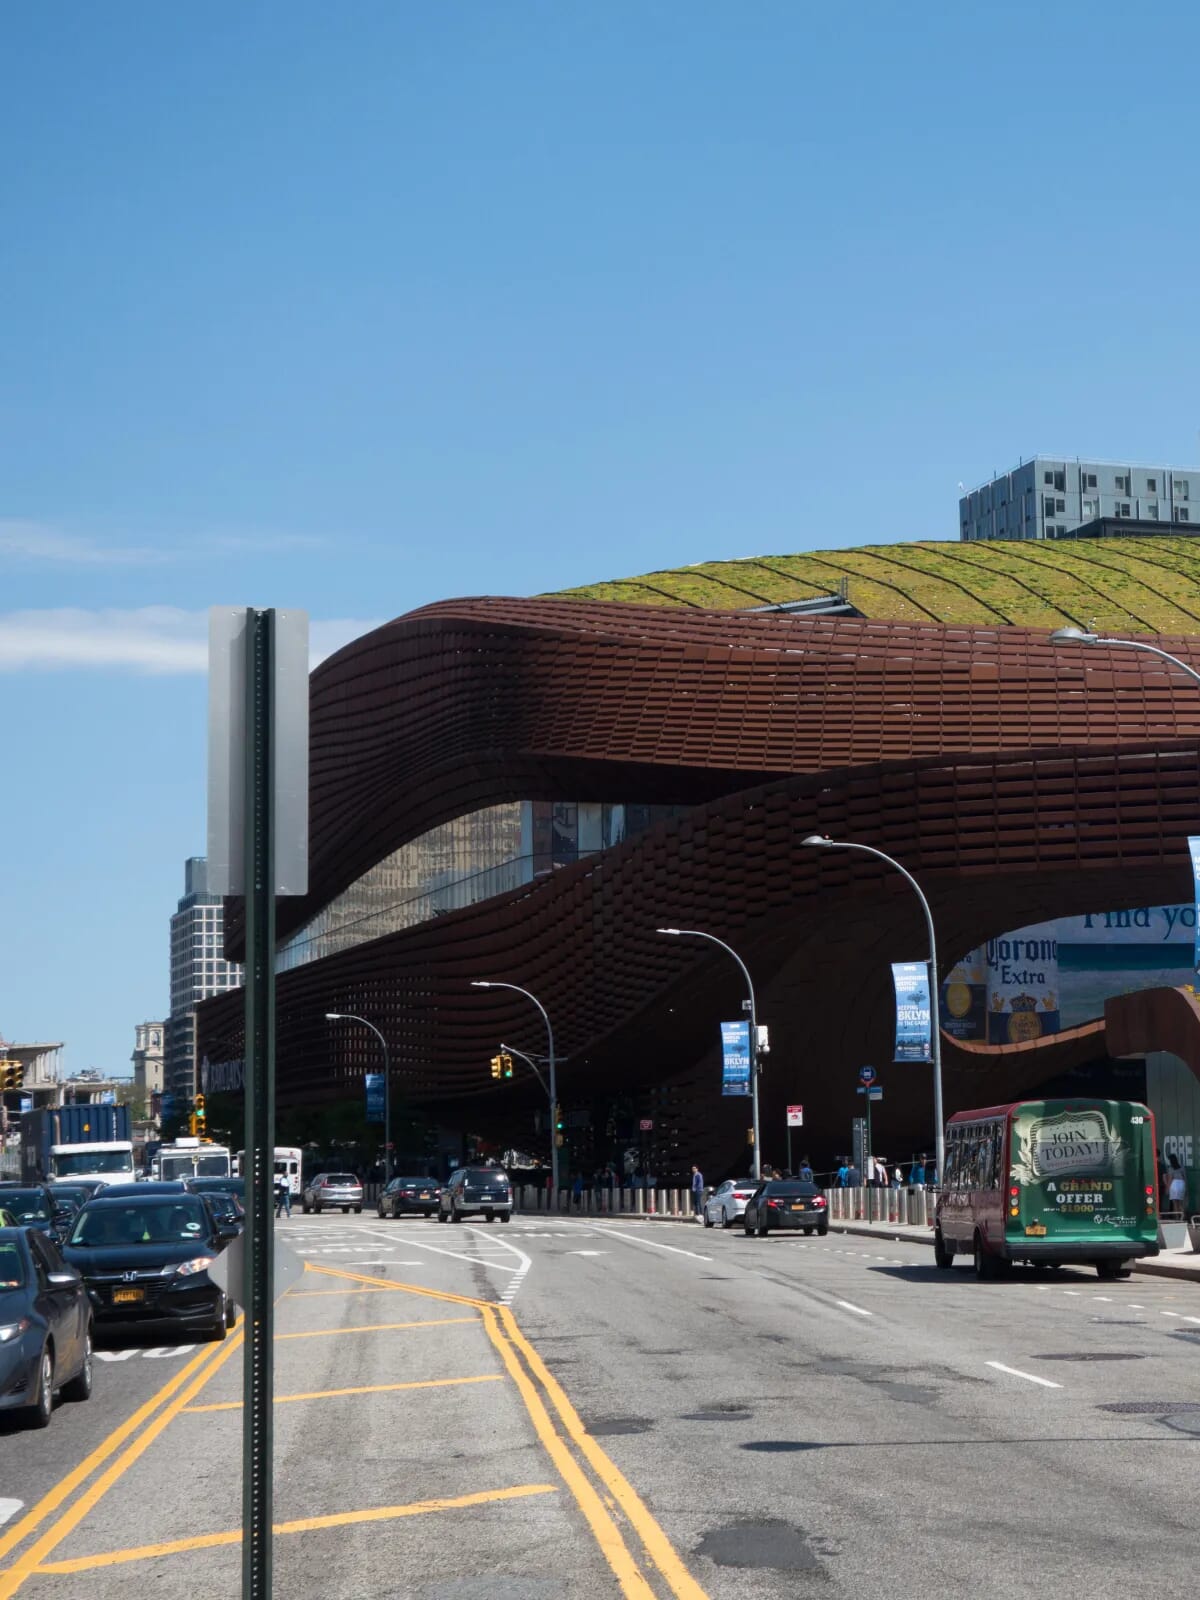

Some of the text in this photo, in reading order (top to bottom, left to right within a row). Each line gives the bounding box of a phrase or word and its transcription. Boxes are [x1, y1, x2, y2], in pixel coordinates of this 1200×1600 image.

[1001, 965, 1046, 985] Extra
[897, 1010, 930, 1021] BKLYN
[1051, 1129, 1087, 1146] JOIN
[1042, 1142, 1100, 1161] TODAY!
[1047, 1182, 1113, 1192] A GRAND
[1056, 1193, 1104, 1204] OFFER
